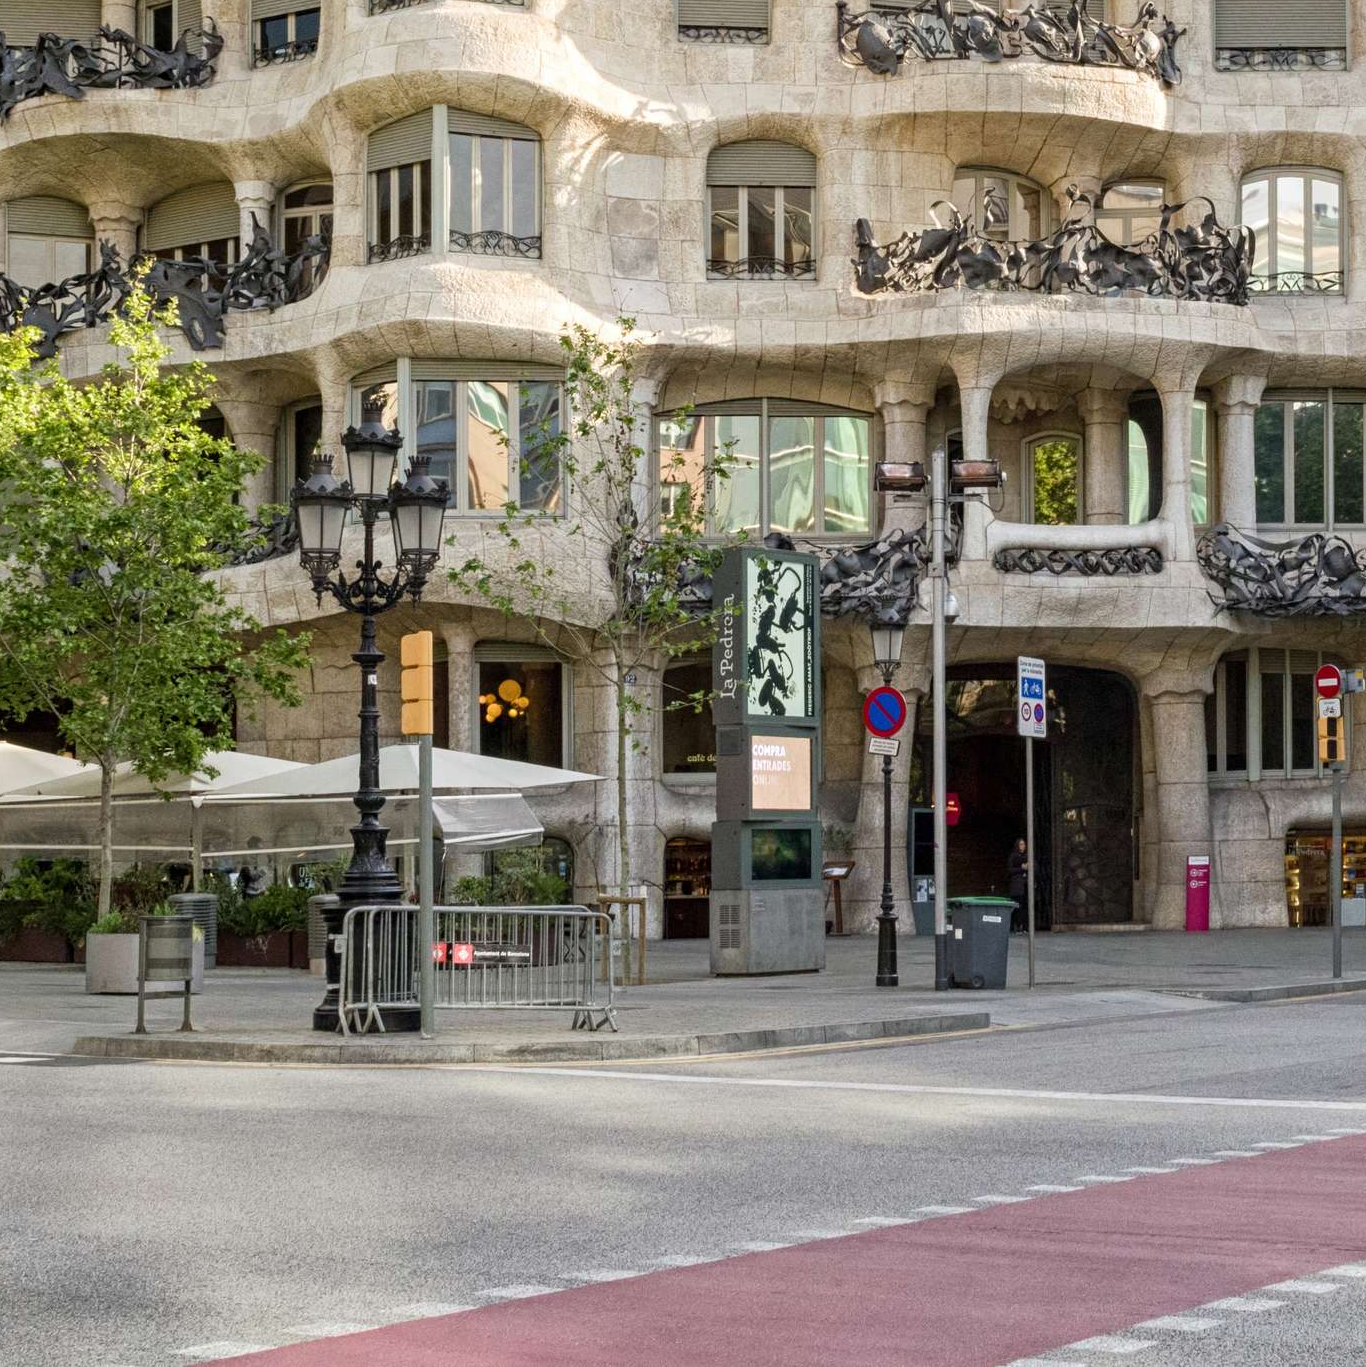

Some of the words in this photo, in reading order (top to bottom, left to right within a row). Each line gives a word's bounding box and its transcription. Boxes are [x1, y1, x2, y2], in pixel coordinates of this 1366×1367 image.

[719, 594, 735, 676] Pedrera
[625, 675, 635, 683] 92
[719, 677, 736, 700] La
[752, 744, 786, 756] COMPRA
[752, 759, 791, 771] ENTRADES
